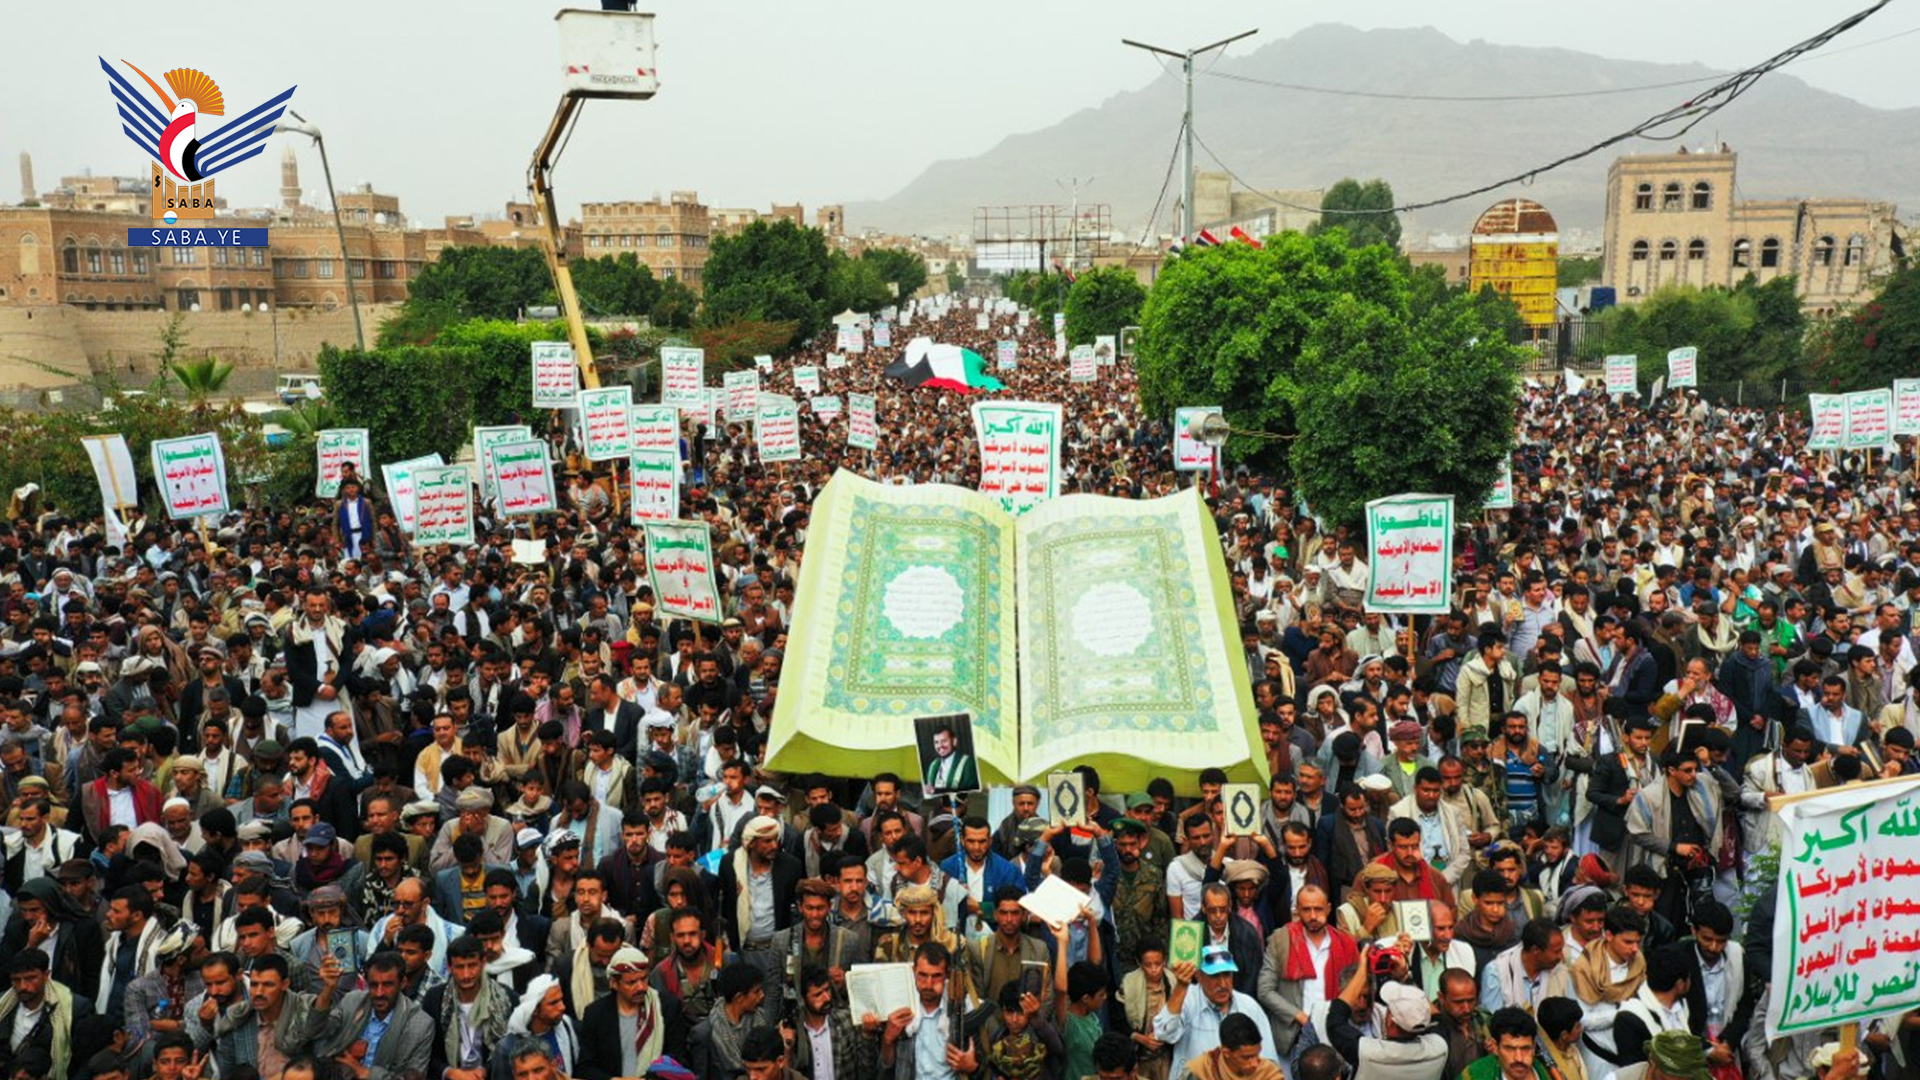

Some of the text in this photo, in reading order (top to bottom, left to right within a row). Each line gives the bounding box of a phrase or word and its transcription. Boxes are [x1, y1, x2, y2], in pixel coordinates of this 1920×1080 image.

[984, 413, 1050, 438] الله أكبر
[1375, 509, 1443, 535] قاطعوا
[1375, 580, 1442, 600] الإسرائيلية
[1878, 797, 1920, 837] لله
[1796, 941, 1843, 979] اليهود
[1846, 936, 1877, 965] على
[1862, 960, 1920, 1006] لنصر
